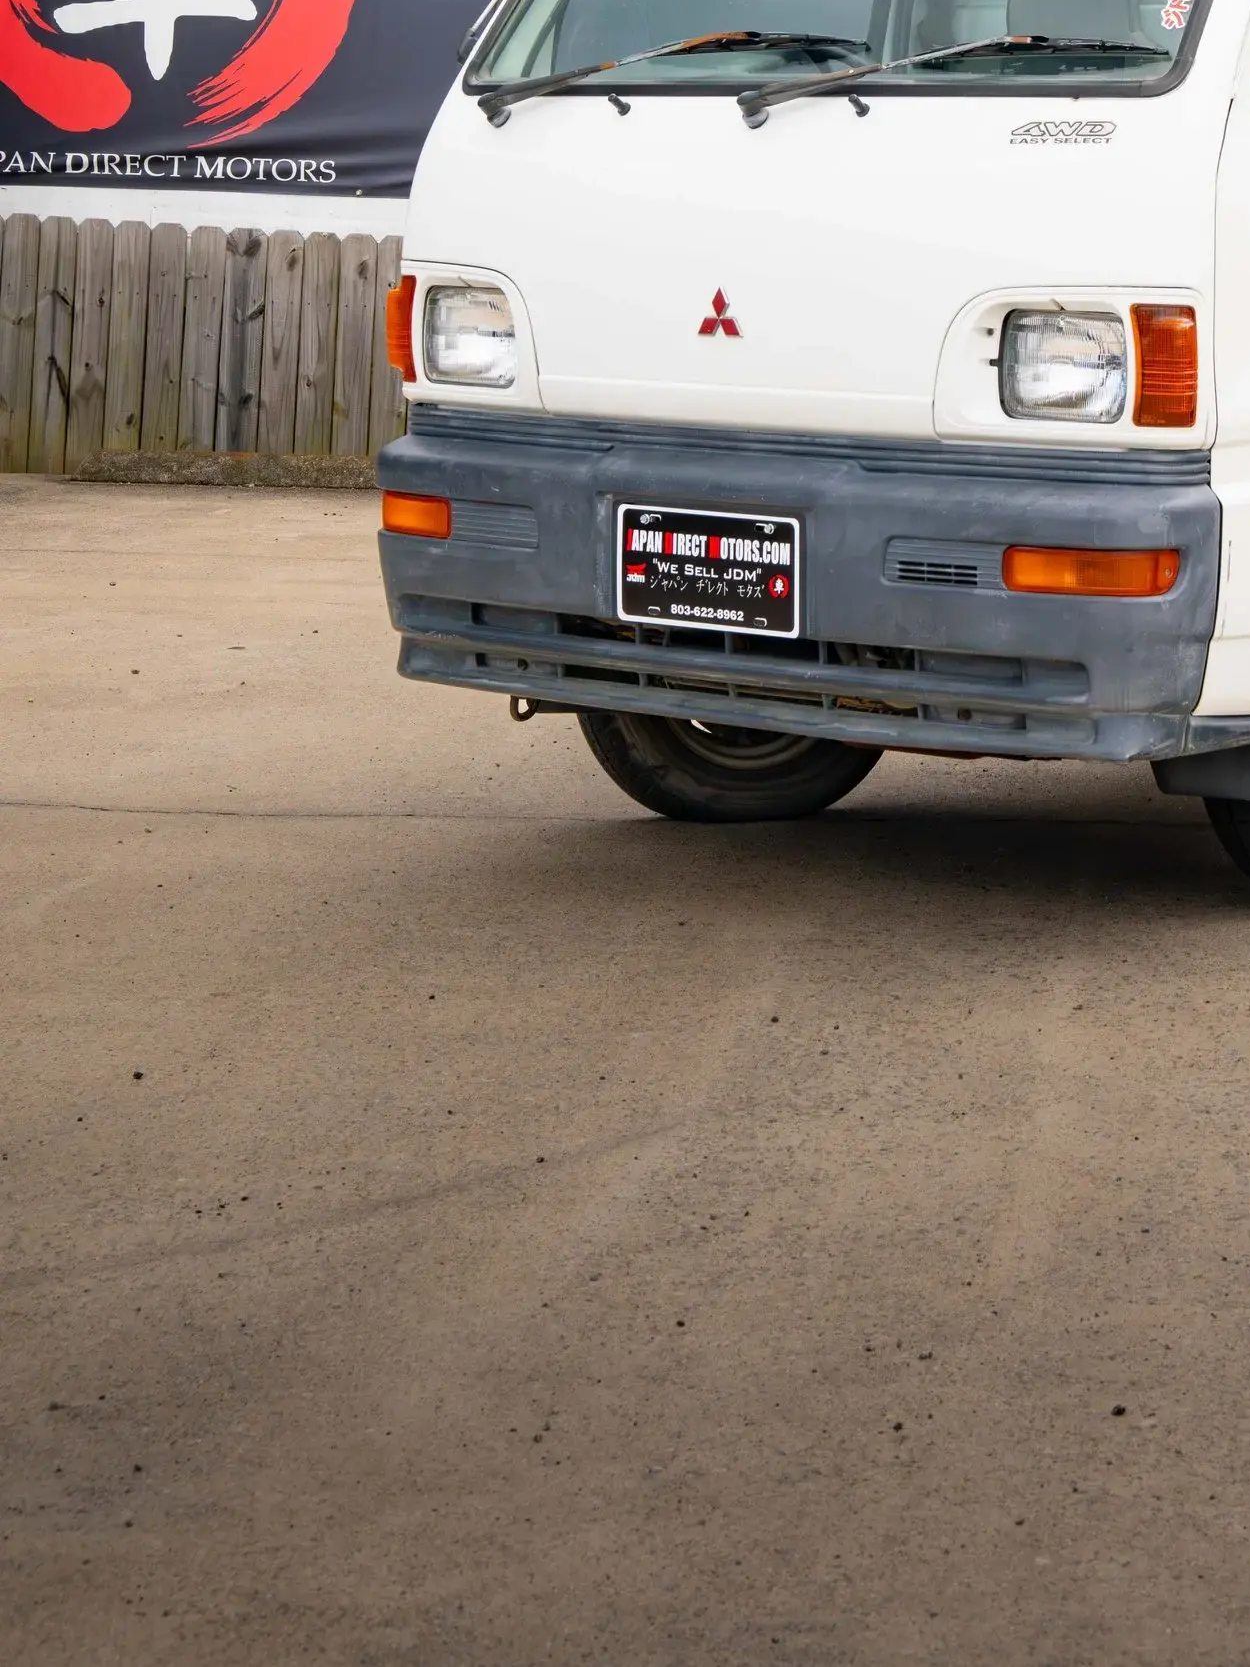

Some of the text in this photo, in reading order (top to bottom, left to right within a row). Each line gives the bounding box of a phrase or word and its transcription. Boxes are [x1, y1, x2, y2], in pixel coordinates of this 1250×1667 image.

[1011, 121, 1117, 136] 4WD
[65, 152, 186, 177] DIRECT
[194, 156, 337, 183] MOTORS
[724, 568, 761, 582] JDM"
[671, 604, 744, 621] 803-622-8962
